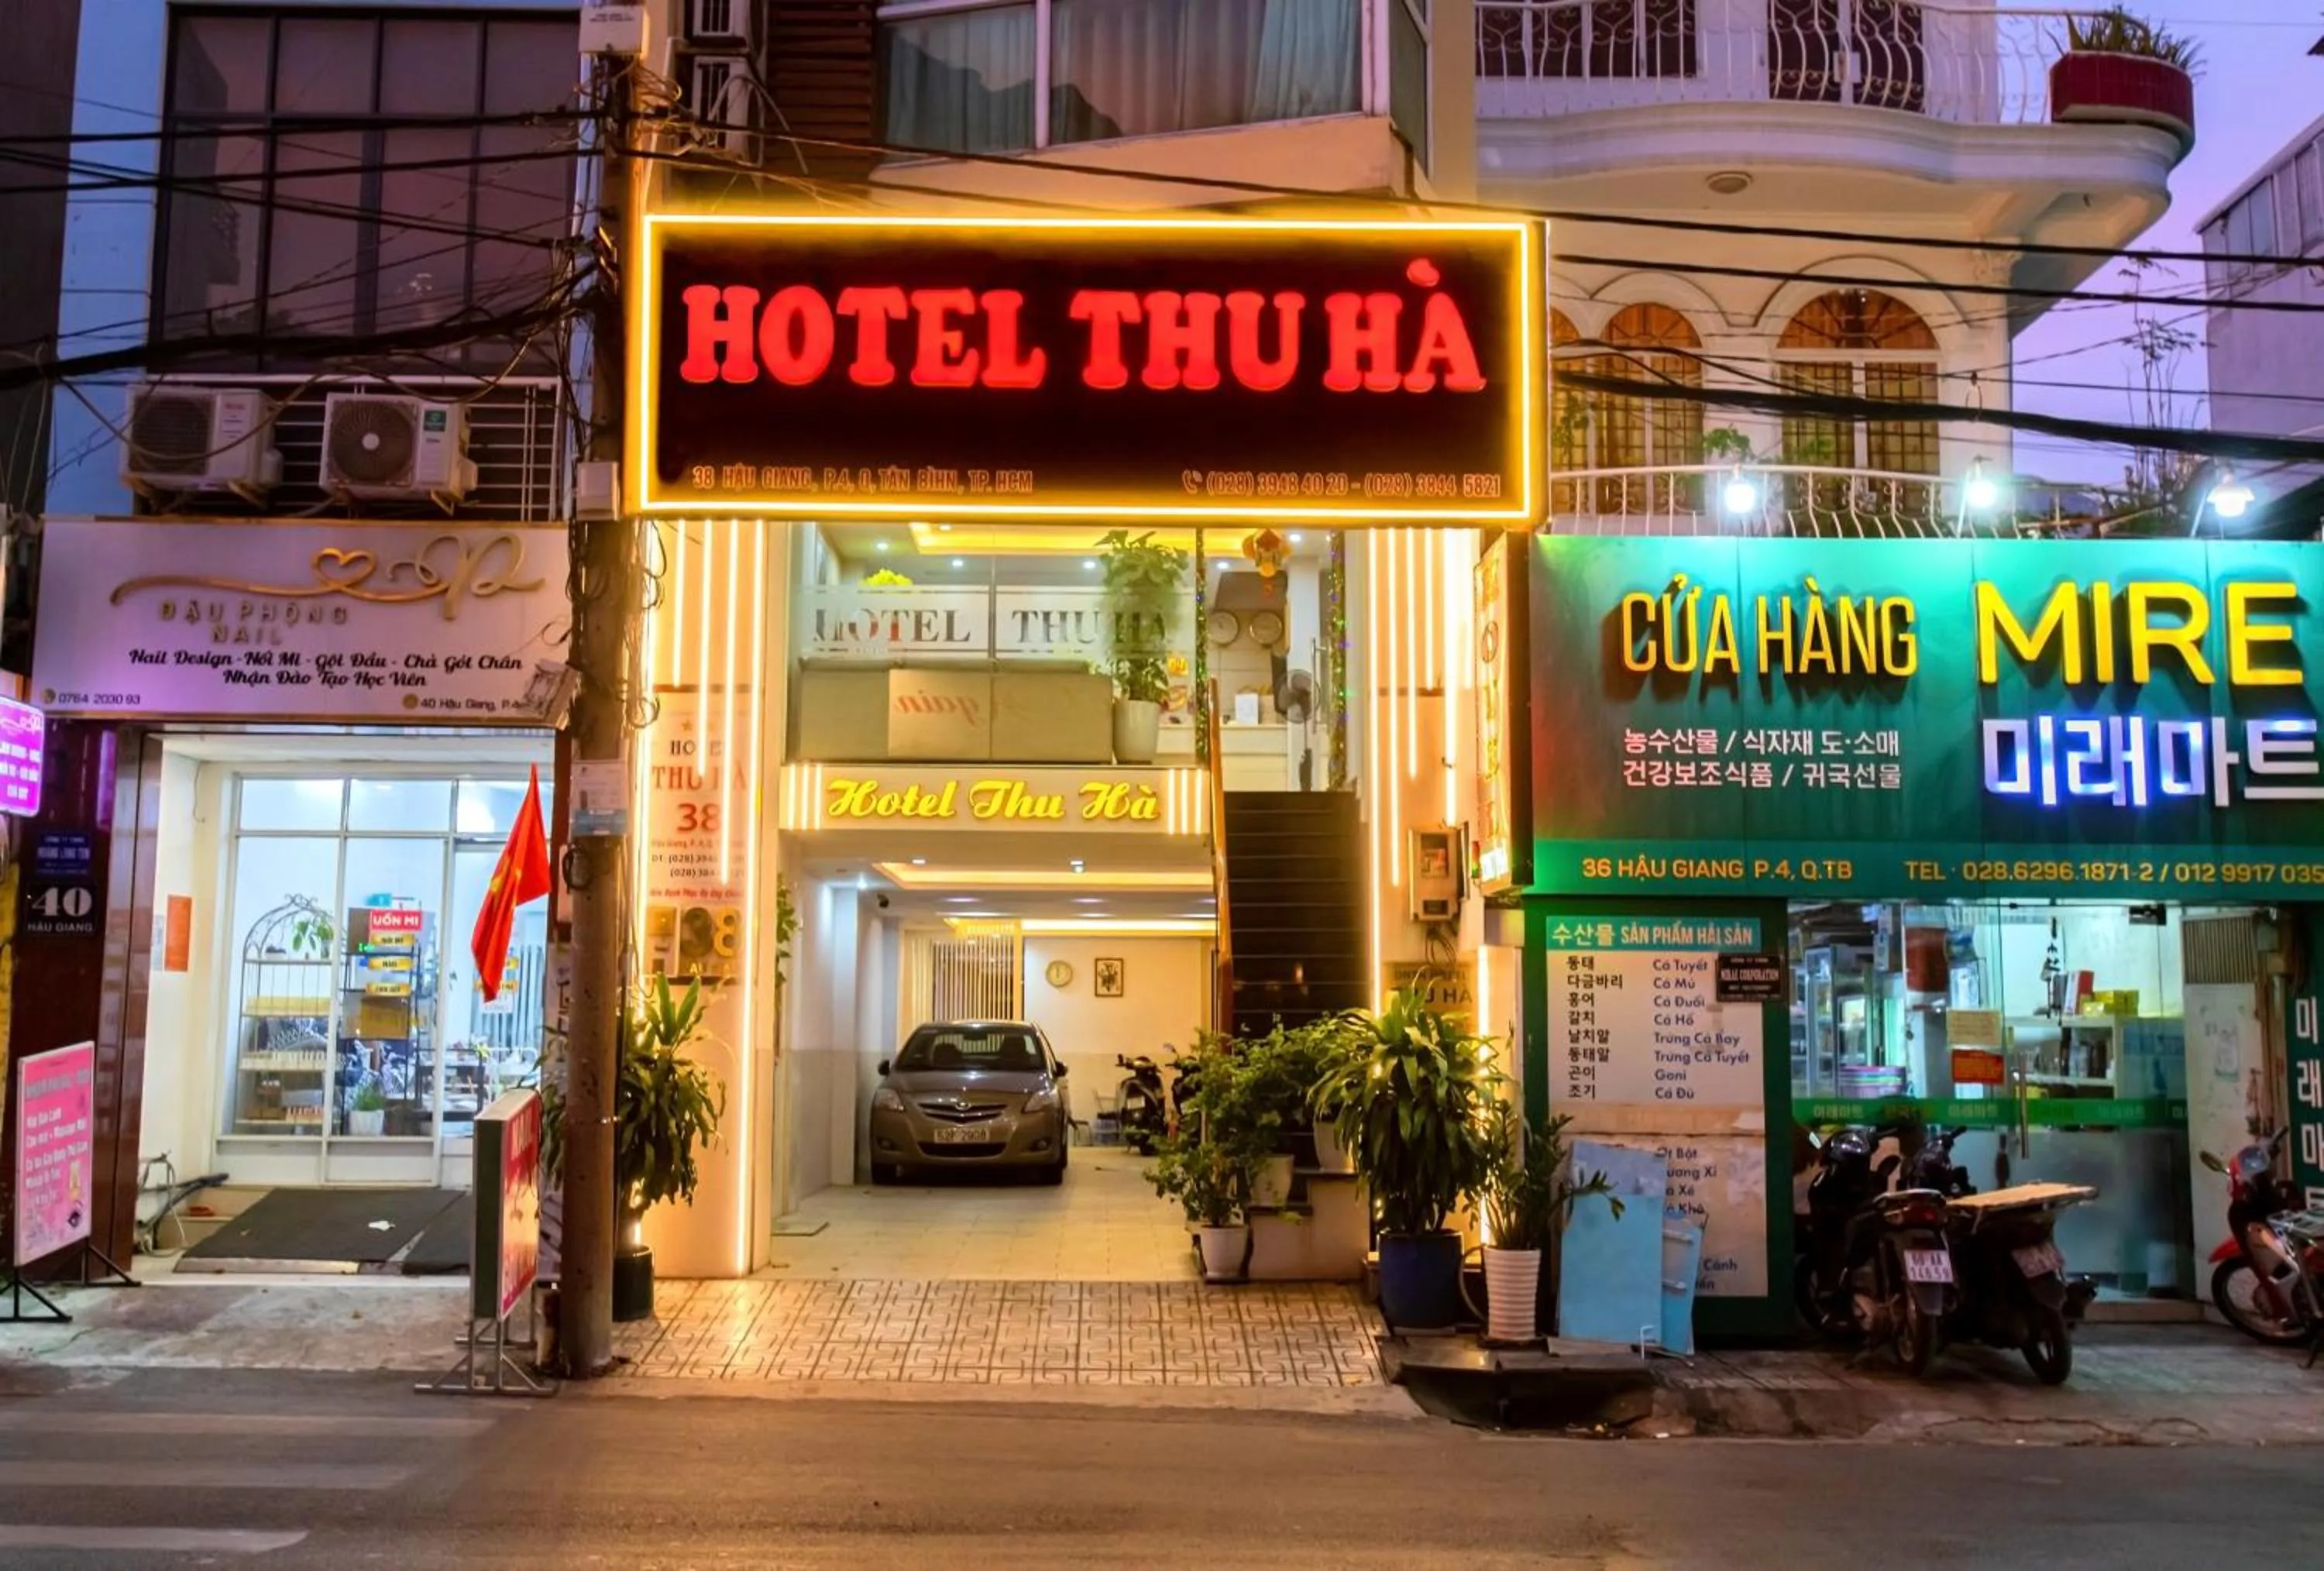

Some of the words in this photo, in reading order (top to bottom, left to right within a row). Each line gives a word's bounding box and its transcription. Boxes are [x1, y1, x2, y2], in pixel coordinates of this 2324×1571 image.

[681, 285, 1046, 389] HOTEL
[1070, 289, 1304, 390] THU
[1322, 257, 1487, 392] HÀ
[693, 466, 713, 488] 38
[995, 470, 1033, 492] HCM
[1757, 576, 1919, 678] HÀNG
[1975, 579, 2304, 687] MIRE
[129, 649, 168, 665] Nail
[174, 651, 232, 669] Design
[1624, 728, 1718, 755] 농수산물
[1743, 730, 1813, 756] 식자재
[1982, 713, 2324, 809] 미래마트
[1623, 761, 1773, 788] 건강보조식품
[1803, 762, 1902, 790] 귀국선물
[827, 779, 957, 818] Hotel
[969, 780, 1065, 820] Thu
[1079, 782, 1158, 820] Hà
[676, 803, 720, 832] 38
[1582, 858, 1612, 878] 36
[1618, 854, 1666, 882] HẬU
[1672, 858, 1744, 879] GIANG
[1801, 860, 1853, 881] Q.TB
[2174, 863, 2216, 883] 012
[2221, 864, 2275, 884] 9917
[32, 888, 93, 917] 40
[404, 916, 419, 926] MI
[1552, 923, 1614, 947] 수산물
[1568, 1084, 1595, 1100] 조기
